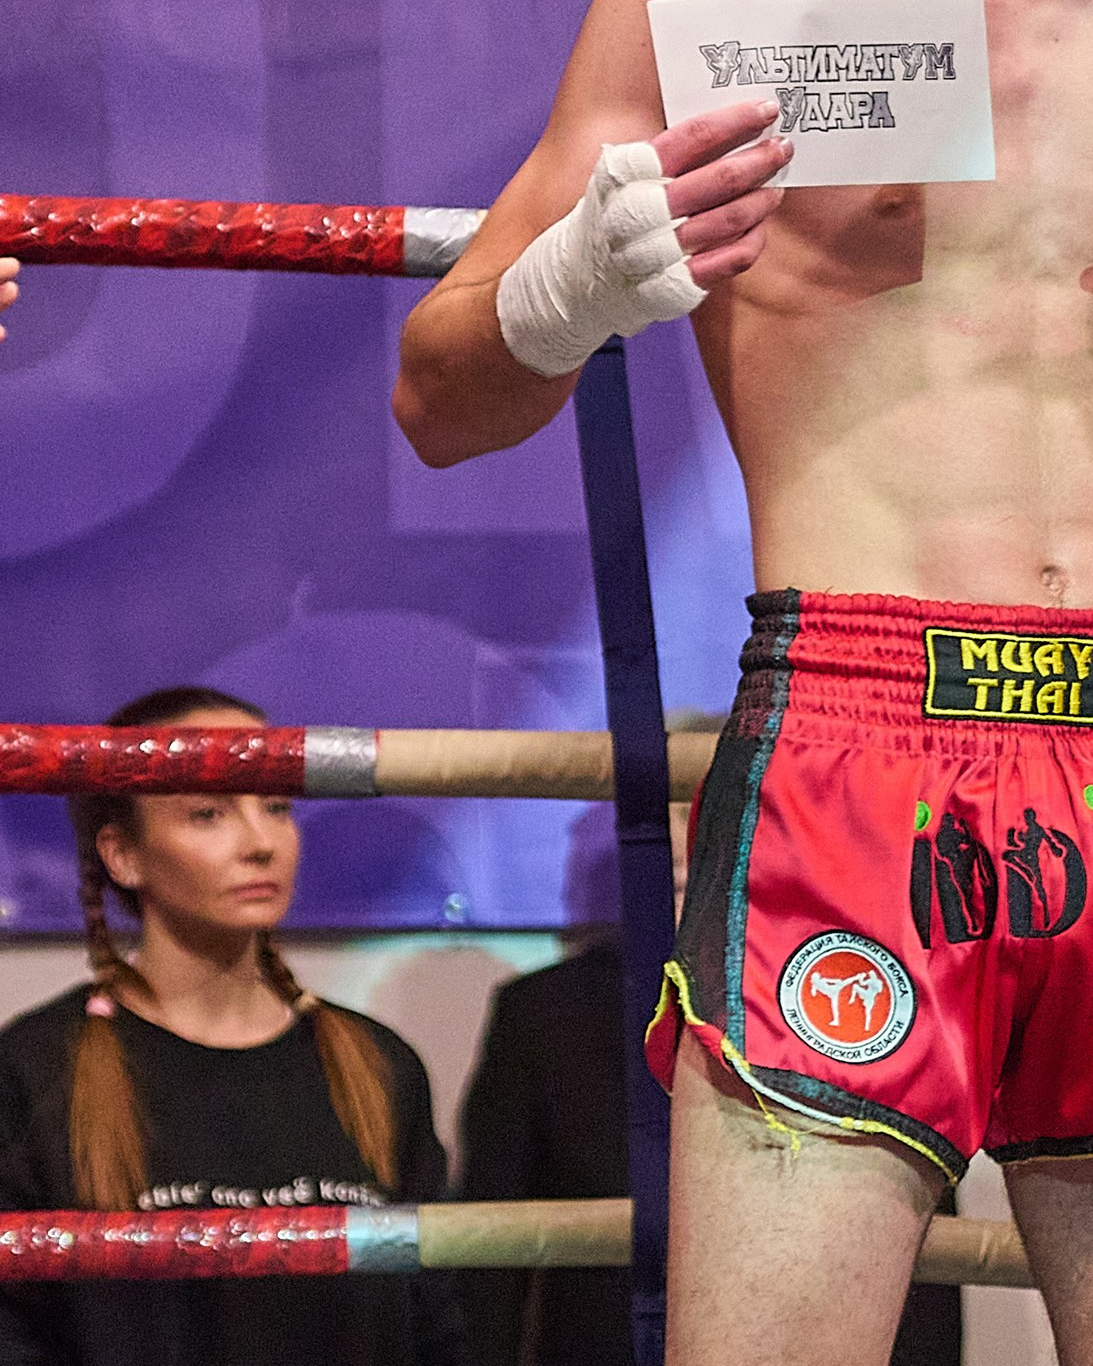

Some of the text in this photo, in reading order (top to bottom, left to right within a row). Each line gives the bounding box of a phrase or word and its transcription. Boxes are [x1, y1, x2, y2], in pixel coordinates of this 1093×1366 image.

[699, 41, 957, 88] УЛЬТИМАТУМ
[775, 86, 896, 133] УДАРА
[966, 676, 1082, 715] THAI
[785, 934, 909, 998] ФЕДЕРАЦИЯ ТАЙСКОГО БОКСА
[785, 1007, 906, 1060] ЛЕНИНГРАДСКОЙ ОБЛАСТИ
